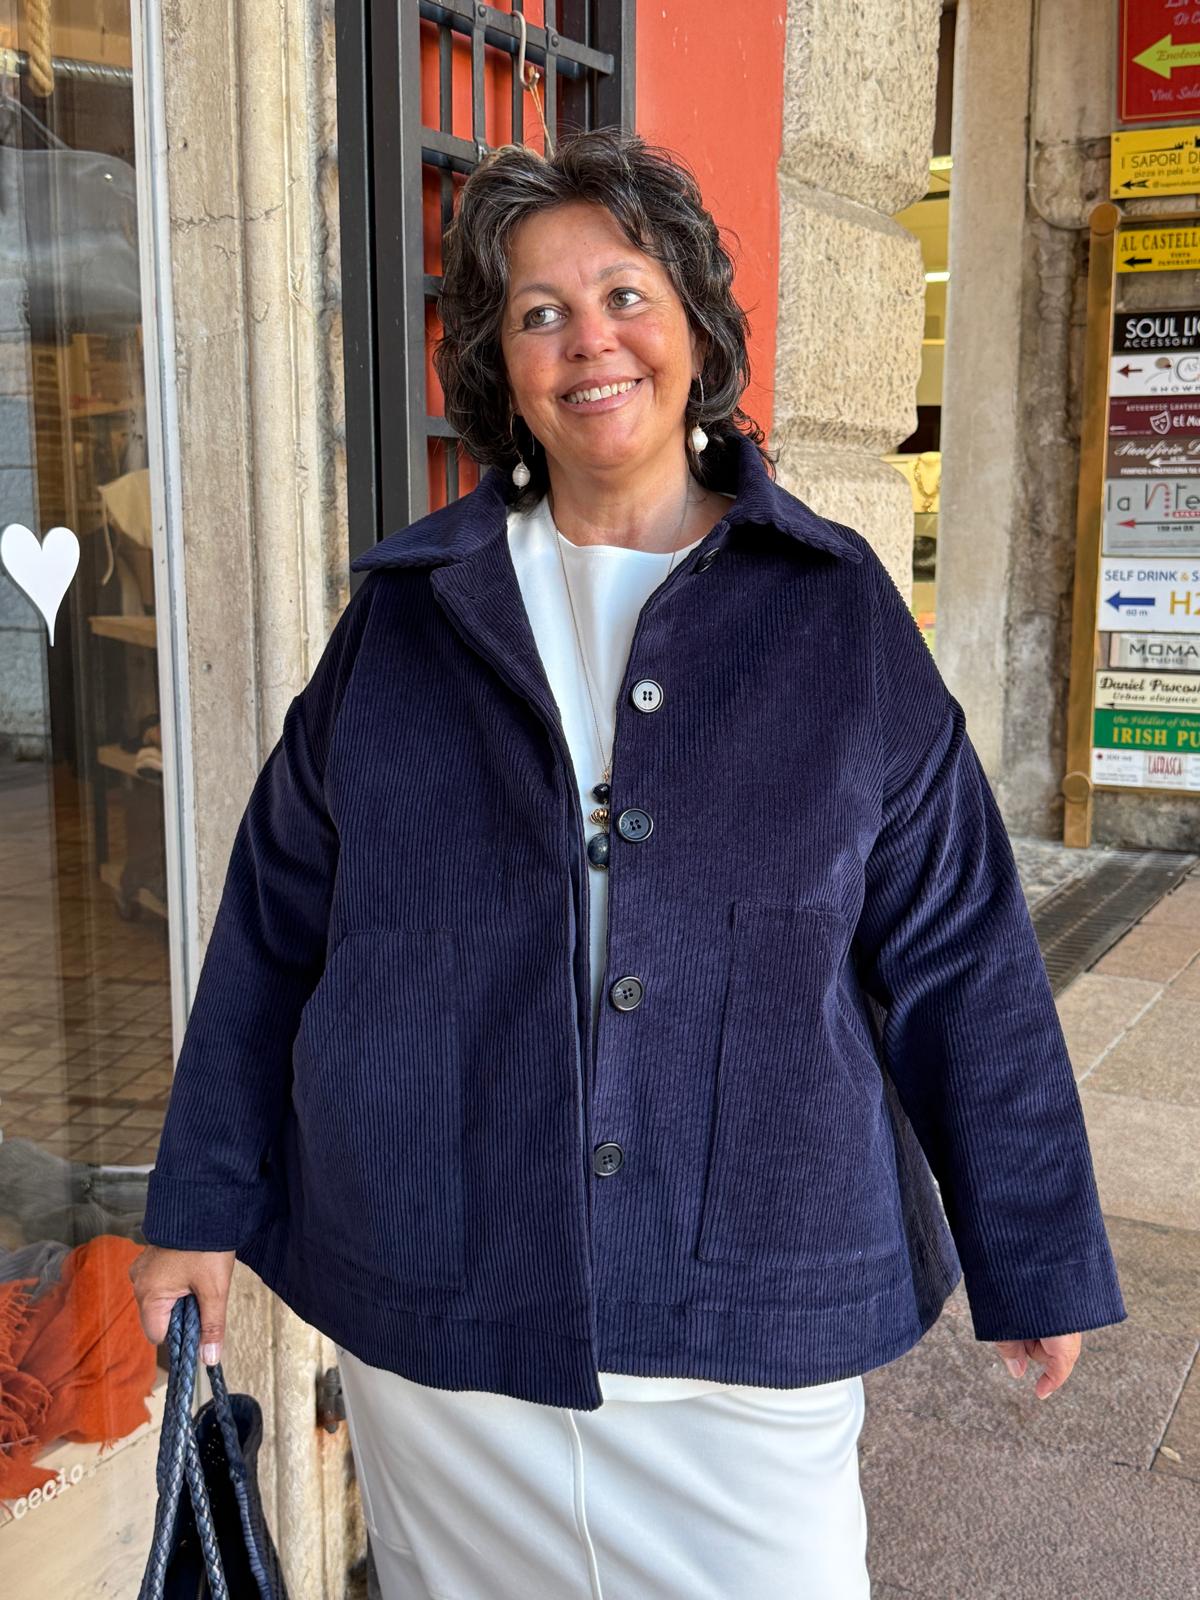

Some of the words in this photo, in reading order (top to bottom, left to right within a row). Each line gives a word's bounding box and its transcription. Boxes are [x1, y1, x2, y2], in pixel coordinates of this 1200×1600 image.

[1131, 153, 1180, 169] SAPORI
[1121, 236, 1136, 252] AL
[1142, 232, 1200, 250] CASTELL
[1125, 317, 1178, 339] SOUL
[1124, 337, 1194, 348] ACCESSORI
[1105, 569, 1133, 581] SELF
[1138, 570, 1177, 582] DRINK
[1129, 643, 1199, 657] MOMA
[1100, 678, 1145, 691] Daniel
[1113, 727, 1167, 746] IRISH
